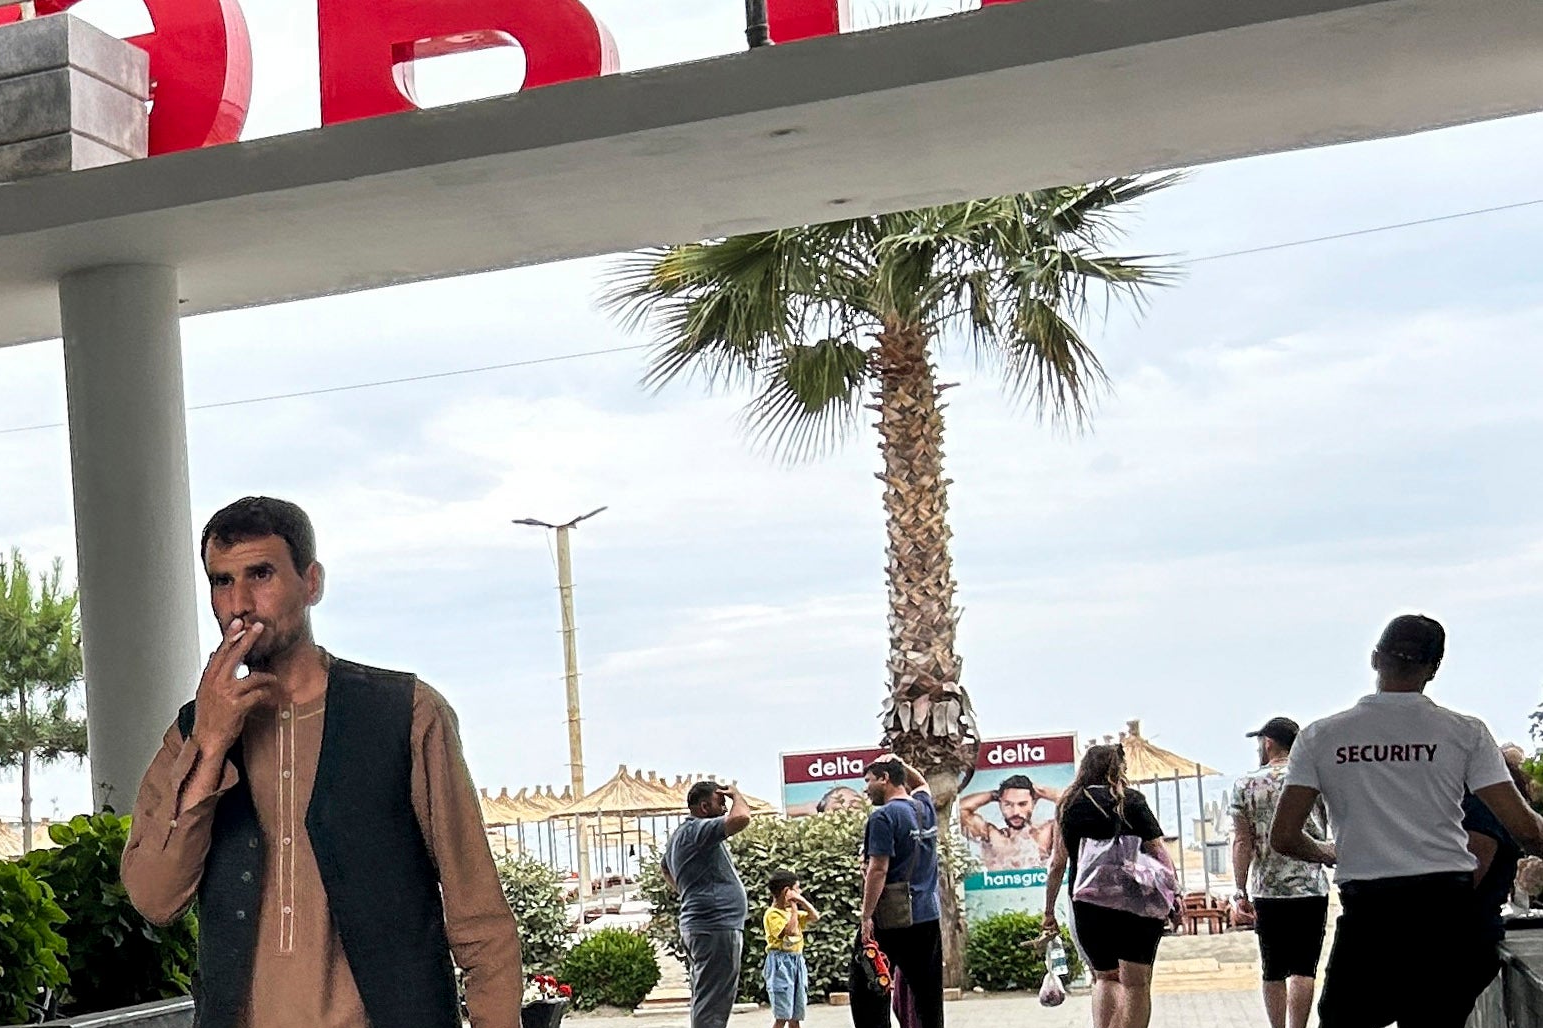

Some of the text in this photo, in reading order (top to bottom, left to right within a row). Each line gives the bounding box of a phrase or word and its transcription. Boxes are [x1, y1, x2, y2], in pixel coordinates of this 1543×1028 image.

[987, 743, 1045, 764] delta
[1336, 744, 1437, 764] SECURITY
[808, 756, 863, 777] delta
[983, 870, 1066, 887] hansgro
